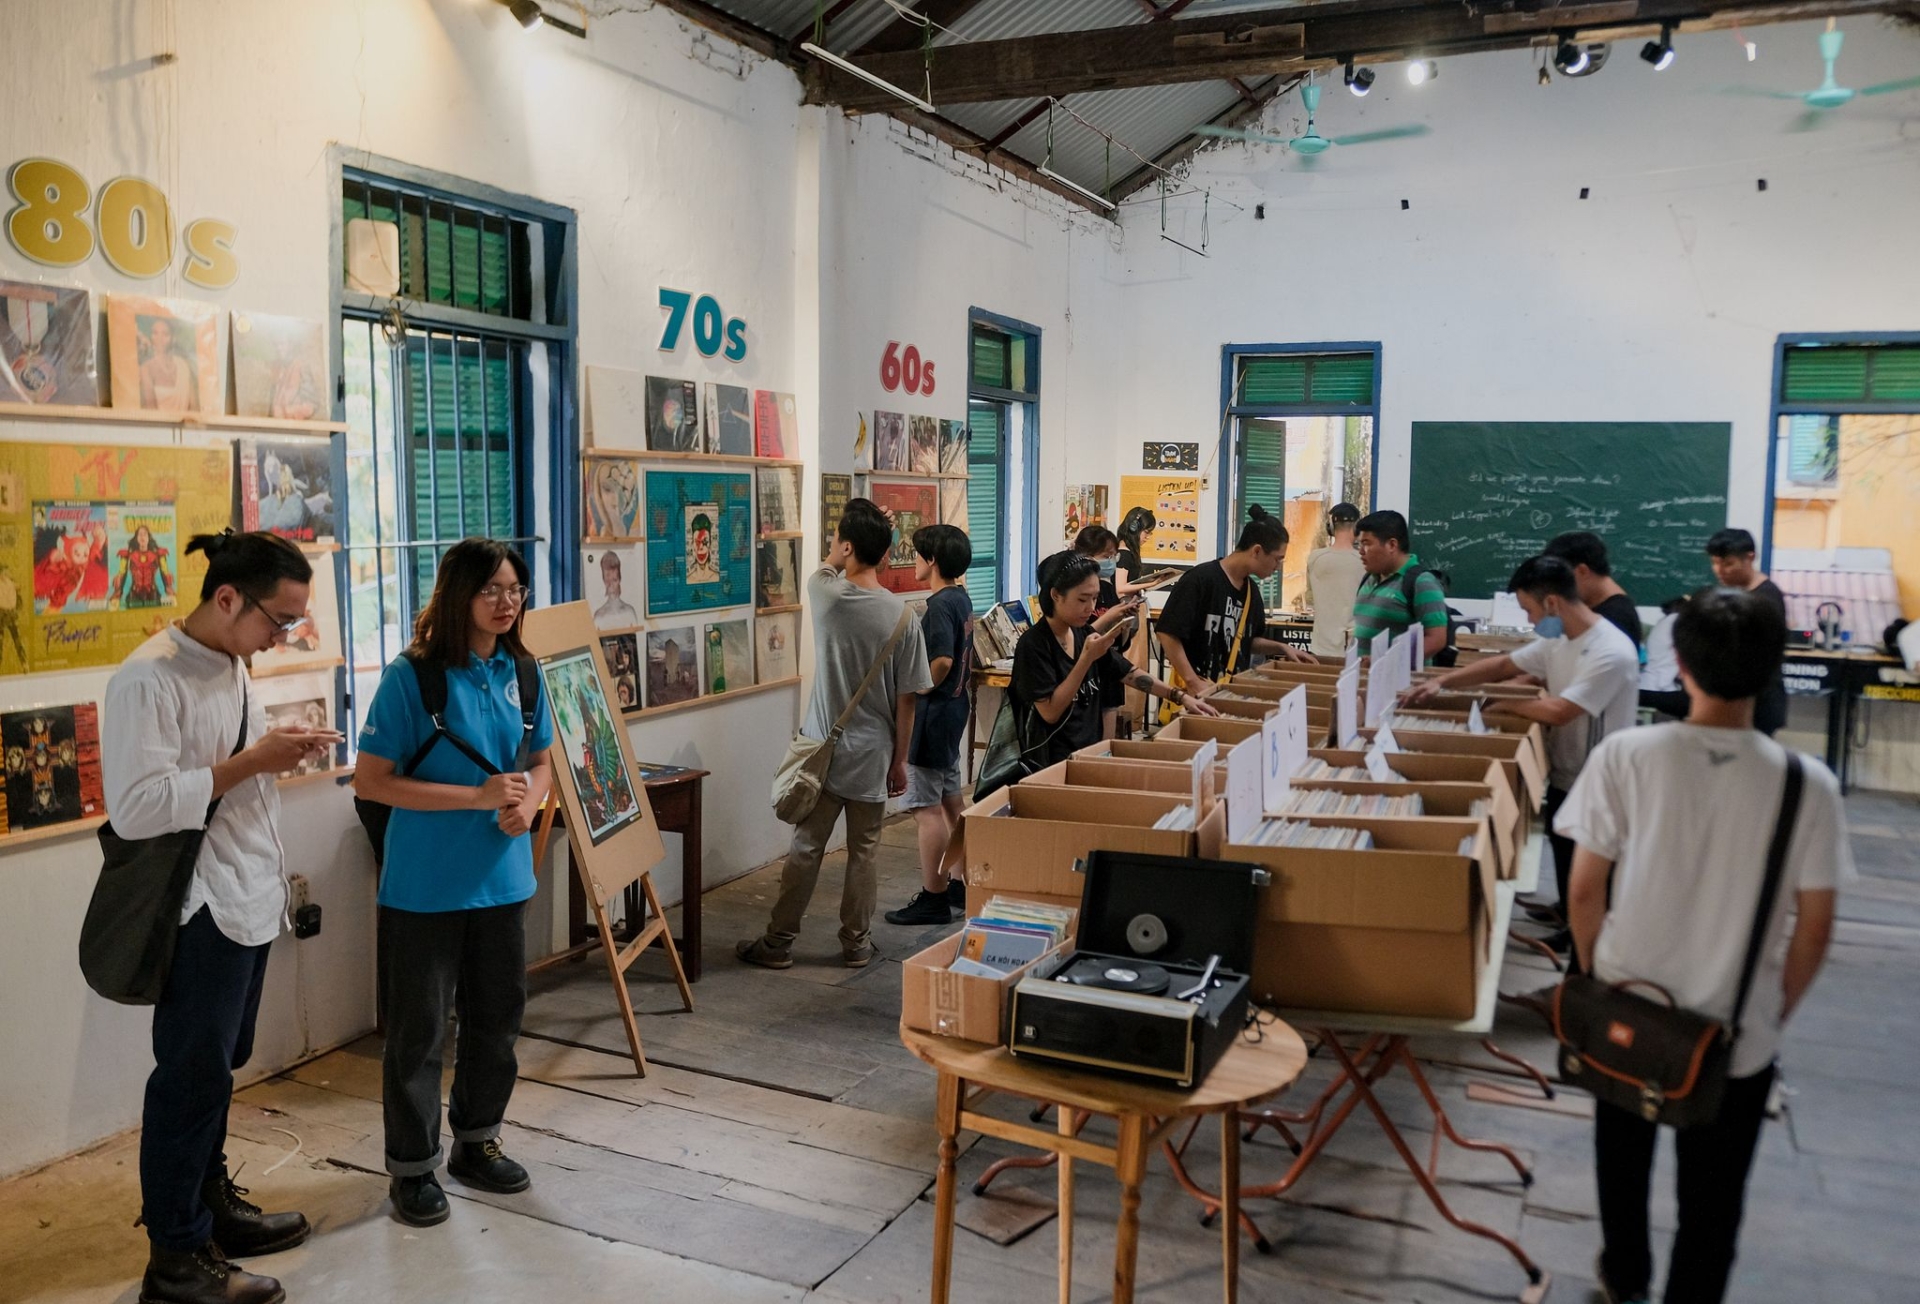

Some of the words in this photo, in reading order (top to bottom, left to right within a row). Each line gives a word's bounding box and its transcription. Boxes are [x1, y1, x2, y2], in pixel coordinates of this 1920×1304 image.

[9, 157, 240, 288] 80s
[658, 286, 748, 363] 70s
[880, 340, 936, 397] 60s
[1288, 642, 1312, 652] STAT
[1783, 678, 1820, 690] TION
